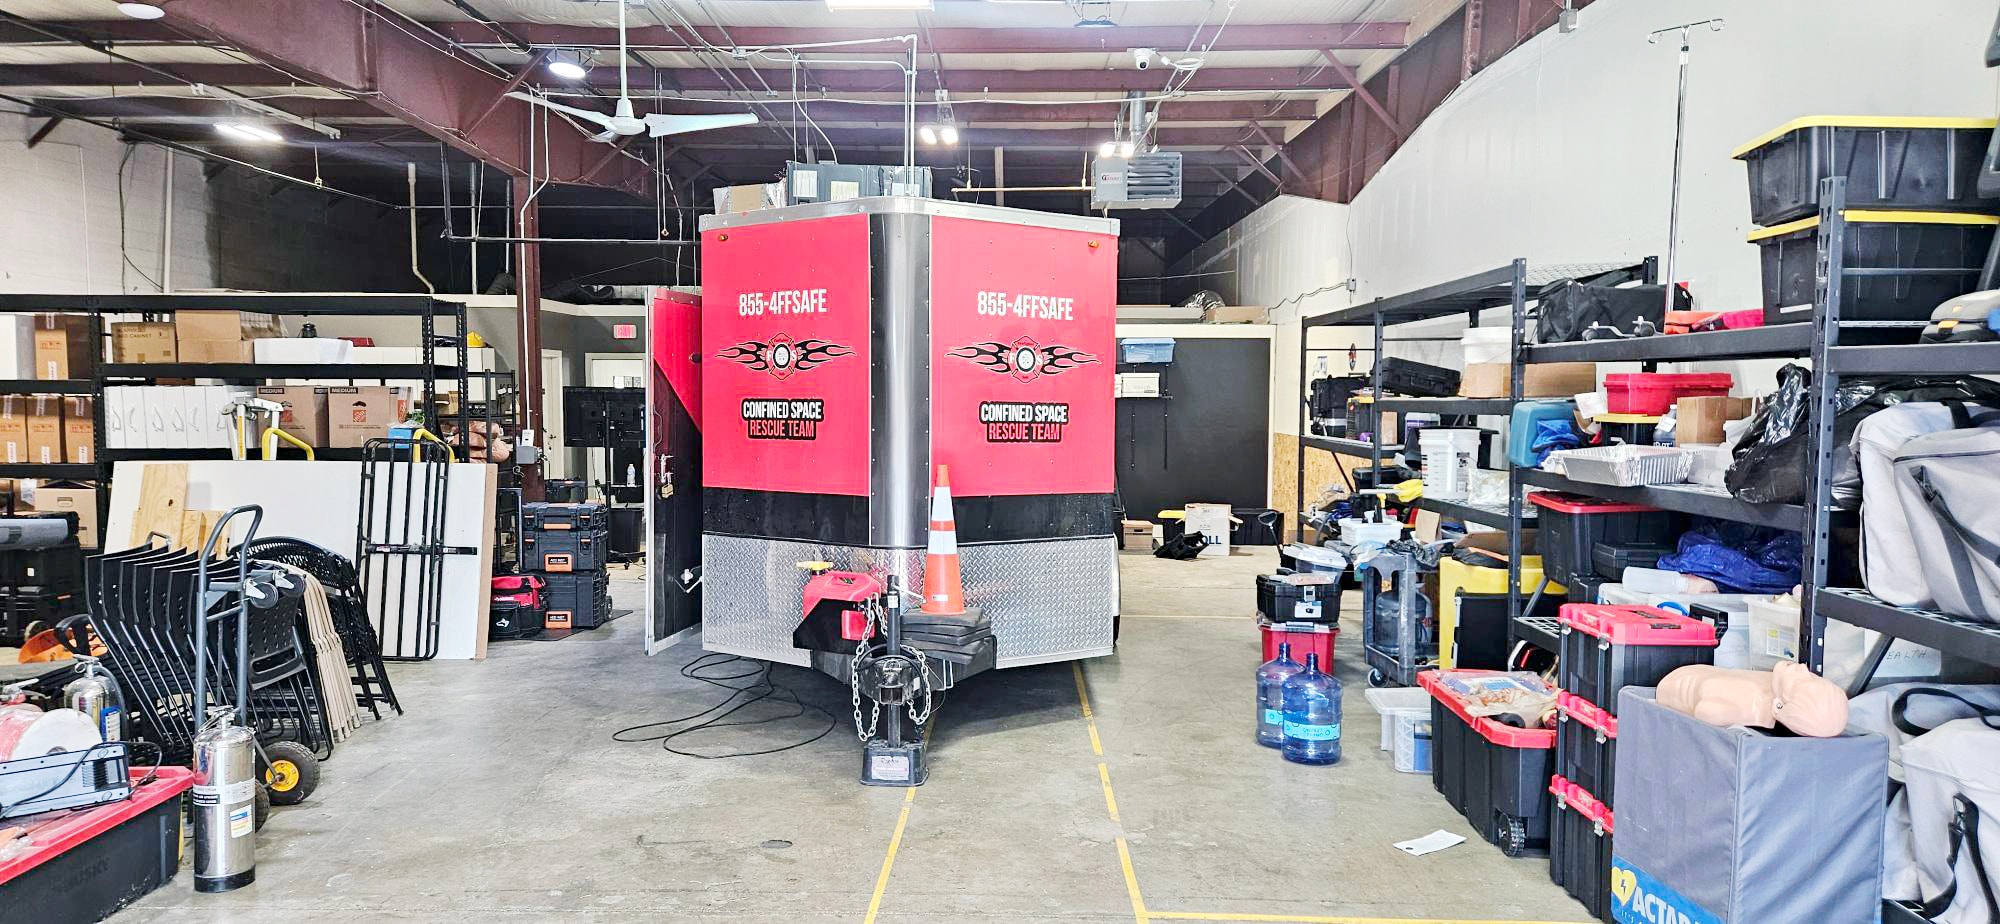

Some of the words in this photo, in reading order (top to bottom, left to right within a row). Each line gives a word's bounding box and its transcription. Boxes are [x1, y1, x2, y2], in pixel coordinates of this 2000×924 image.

[739, 289, 827, 316] 855-4FFSAFE
[977, 291, 1073, 320] 855-4FFSAFE
[743, 401, 788, 419] CONFINED
[790, 401, 822, 419] SPACE
[981, 404, 1032, 422] CONFINED
[1034, 405, 1068, 423] SPACE
[750, 420, 786, 437] RESCUE
[787, 421, 815, 438] TEAM
[989, 423, 1028, 440] RESCUE
[1031, 424, 1060, 441] TEAM
